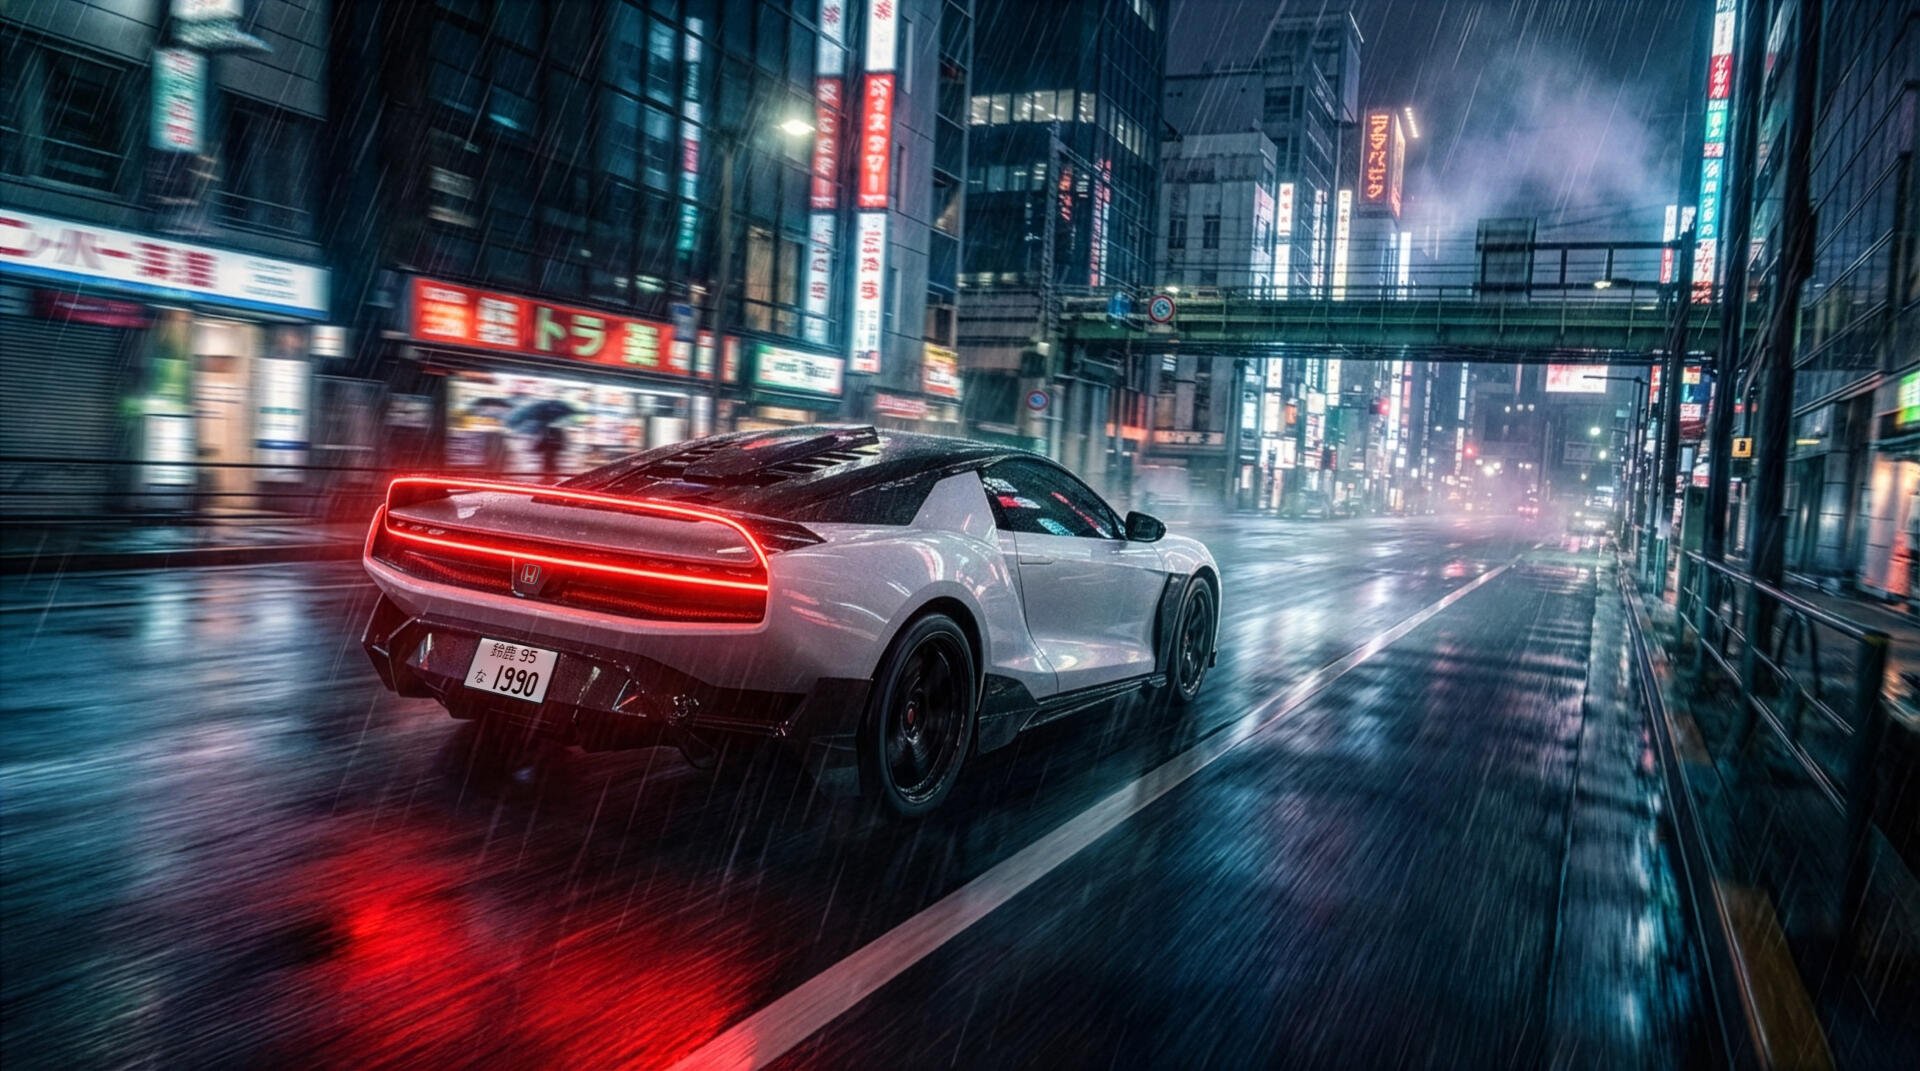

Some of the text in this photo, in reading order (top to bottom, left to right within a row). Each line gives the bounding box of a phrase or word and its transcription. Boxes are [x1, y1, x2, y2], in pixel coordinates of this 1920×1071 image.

[489, 642, 538, 664] 鈴鹿 95
[474, 665, 539, 697] な 1990
